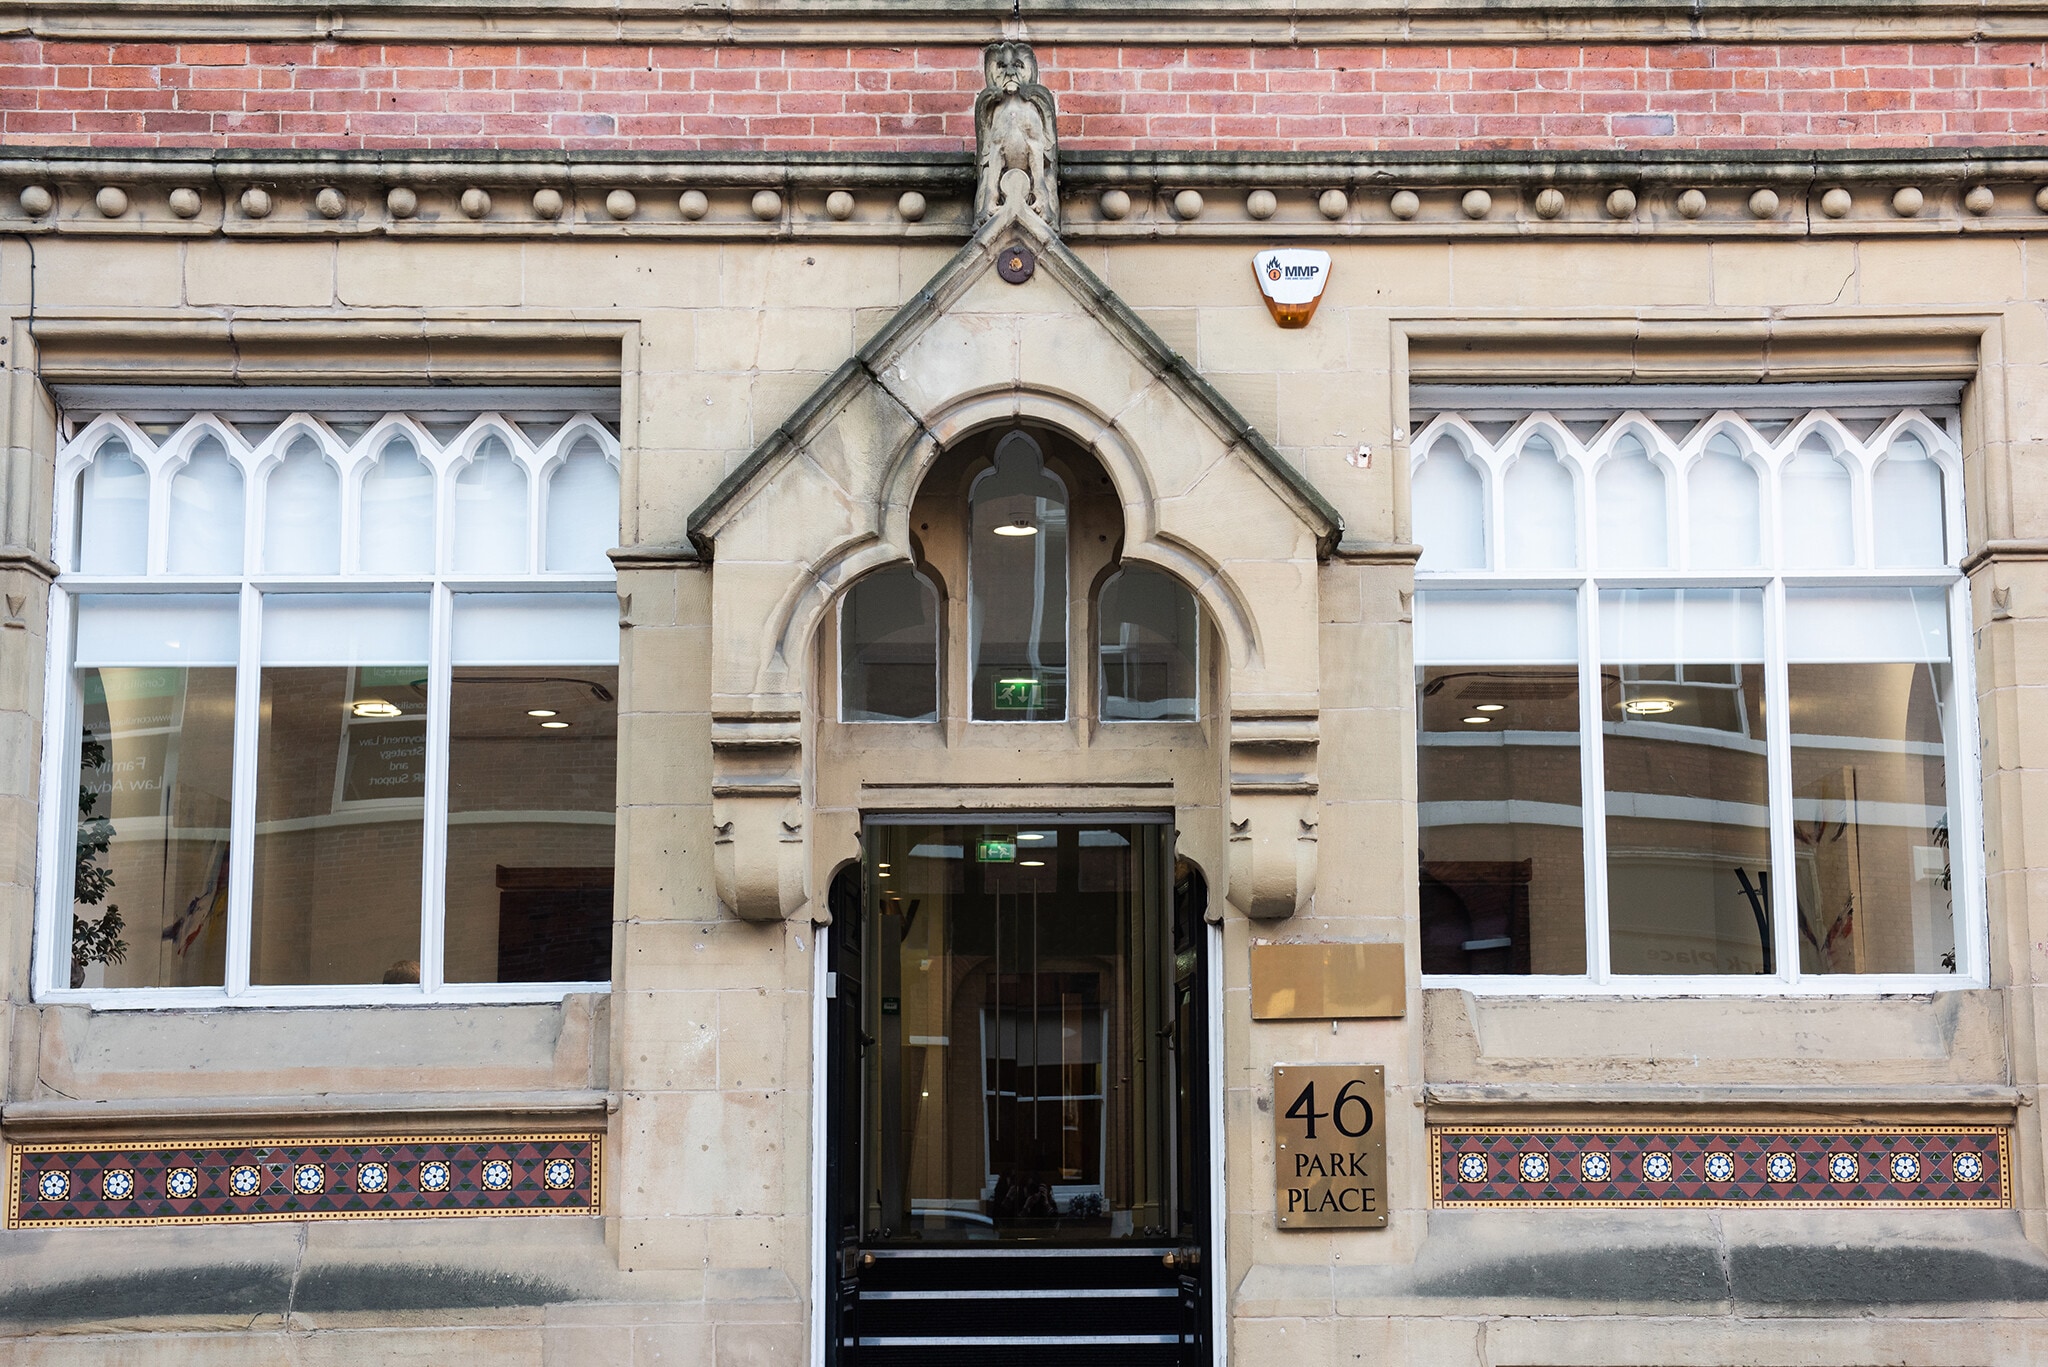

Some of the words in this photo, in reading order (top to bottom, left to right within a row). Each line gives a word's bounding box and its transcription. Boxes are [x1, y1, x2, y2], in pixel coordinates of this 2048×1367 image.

[1285, 266, 1319, 277] MMP
[1284, 1079, 1374, 1140] 46
[1295, 1152, 1369, 1178] PARK
[1288, 1187, 1376, 1213] PLACE
